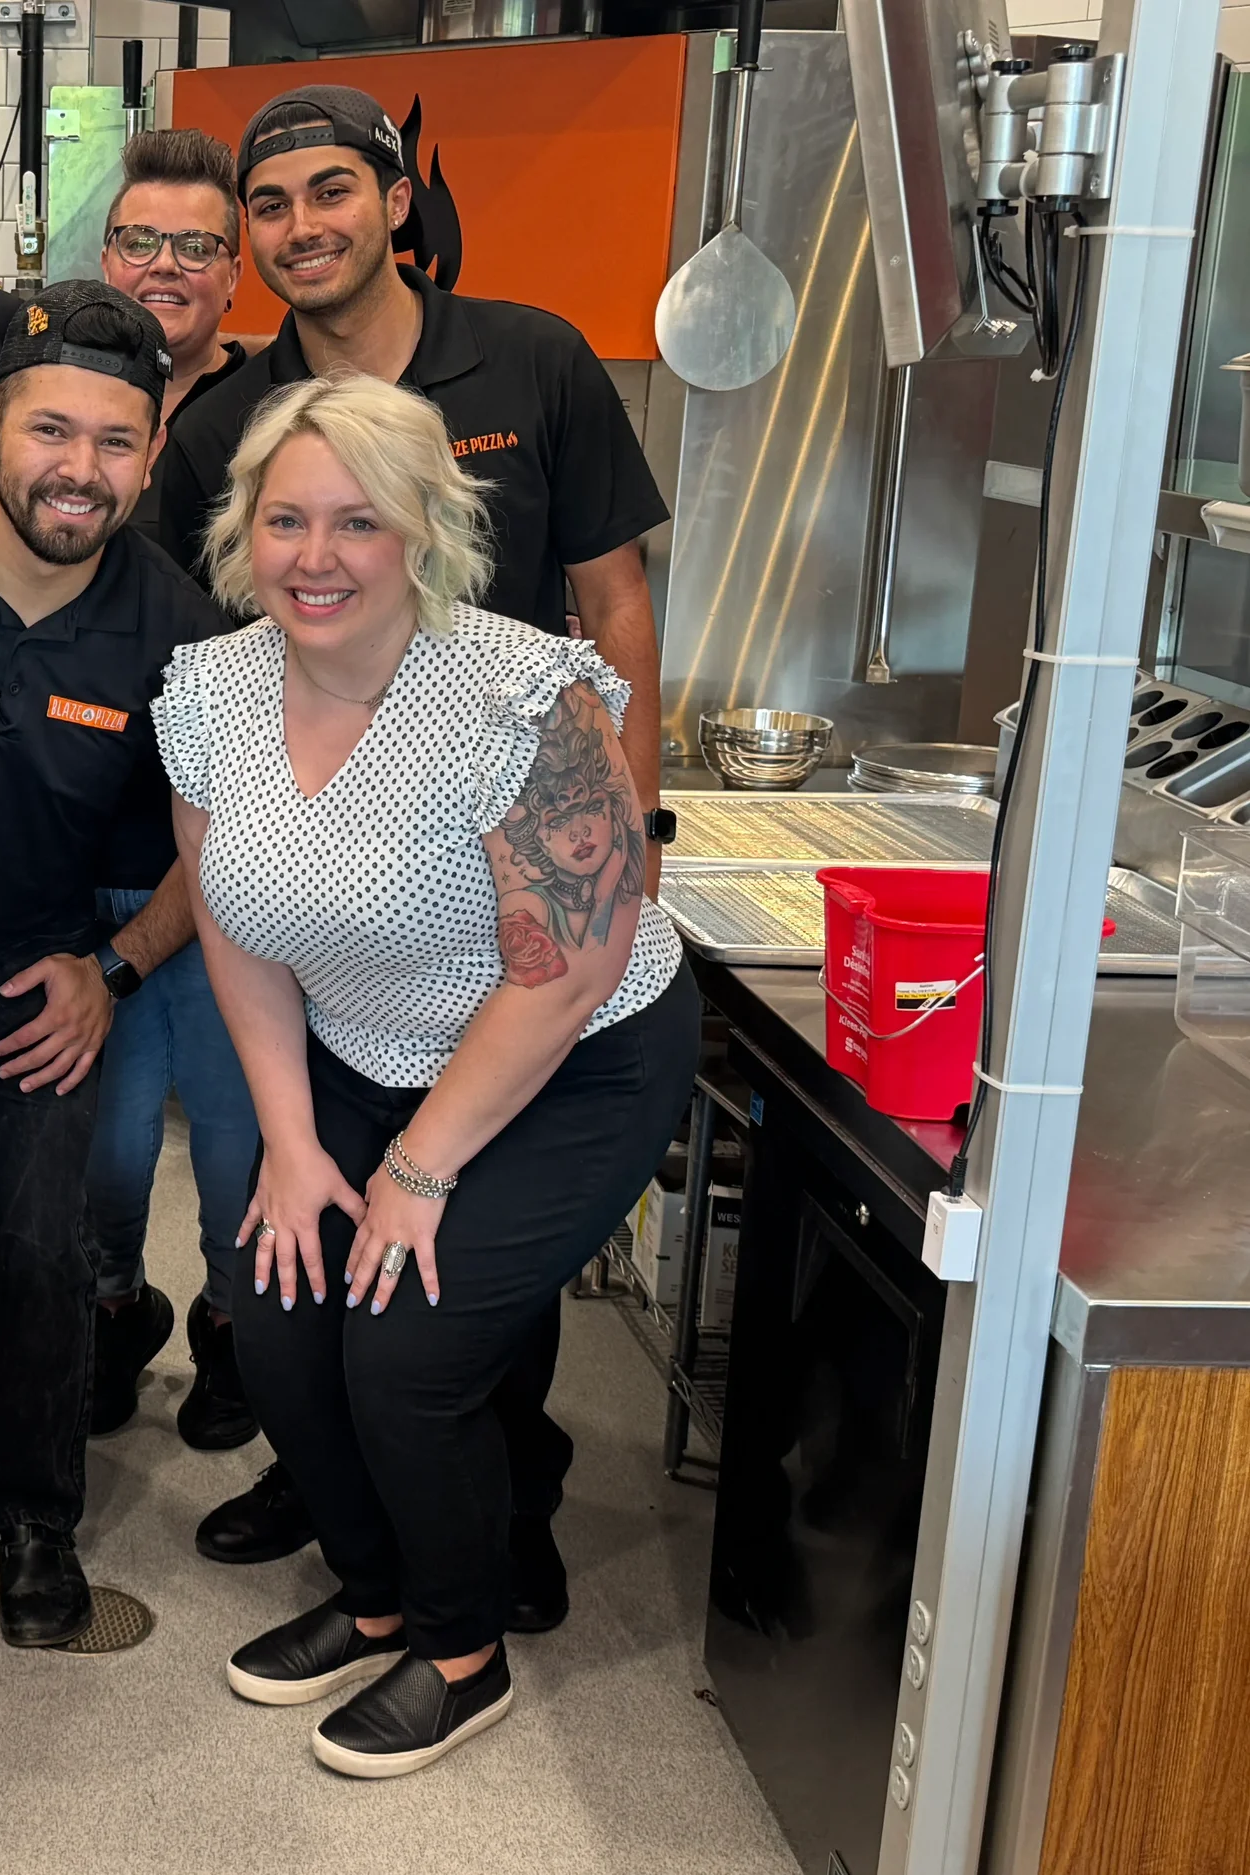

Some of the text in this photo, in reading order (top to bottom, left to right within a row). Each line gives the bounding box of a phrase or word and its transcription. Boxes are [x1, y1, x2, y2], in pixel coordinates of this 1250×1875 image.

[375, 127, 397, 152] ALEX
[470, 432, 505, 454] PIZZA
[51, 698, 124, 729] BLAZE PIZZA
